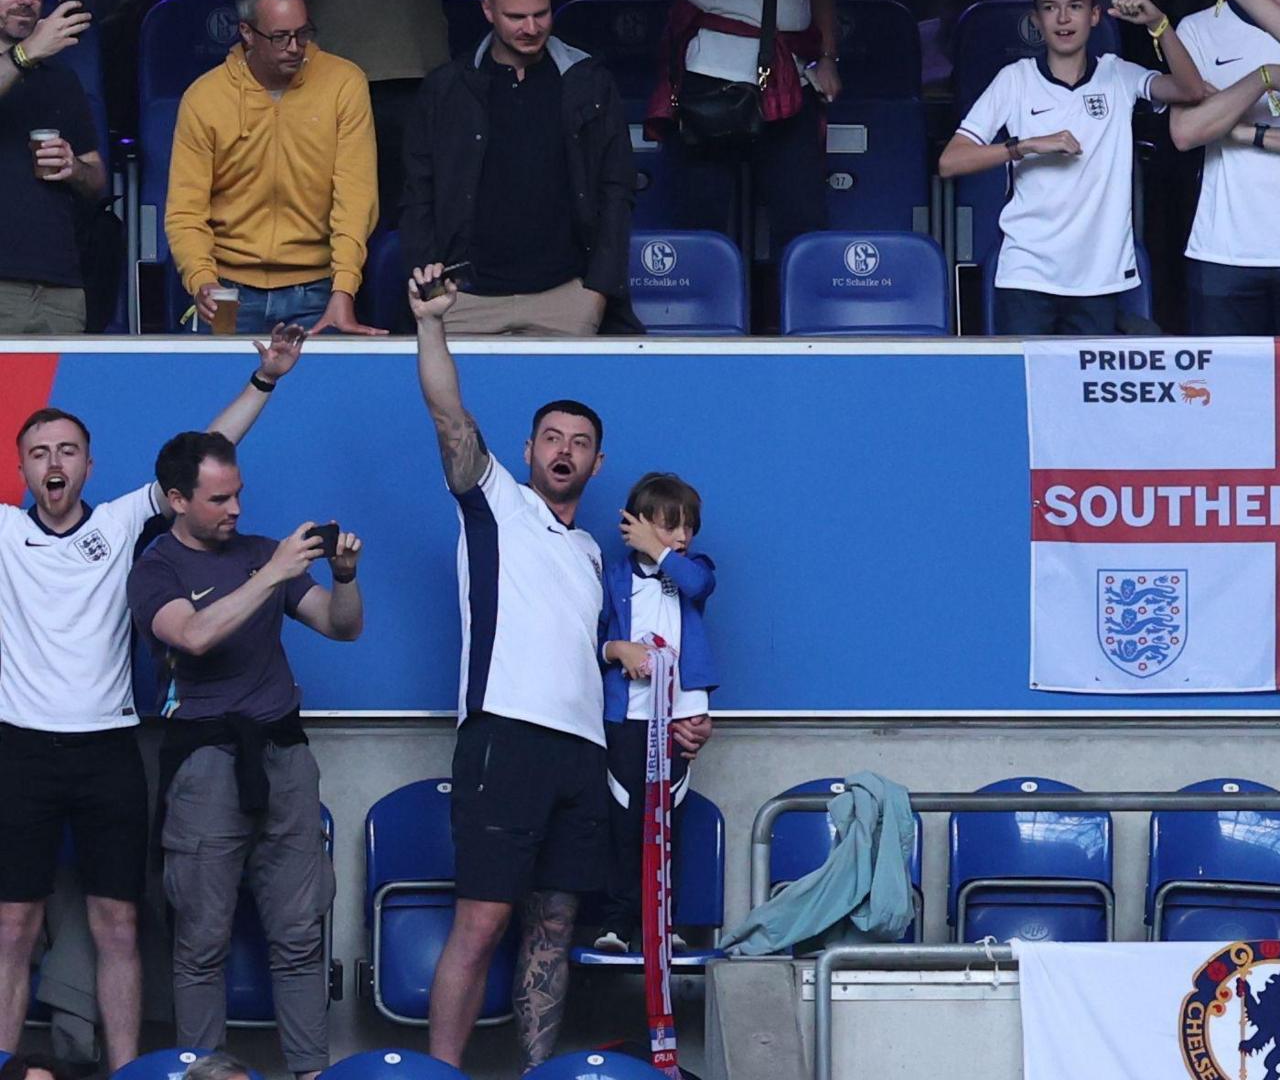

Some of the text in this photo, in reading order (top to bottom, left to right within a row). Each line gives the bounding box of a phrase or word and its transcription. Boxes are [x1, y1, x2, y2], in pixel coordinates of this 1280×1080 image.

[1079, 348, 1213, 371] PRIDE OF
[1082, 380, 1177, 404] ESSEX
